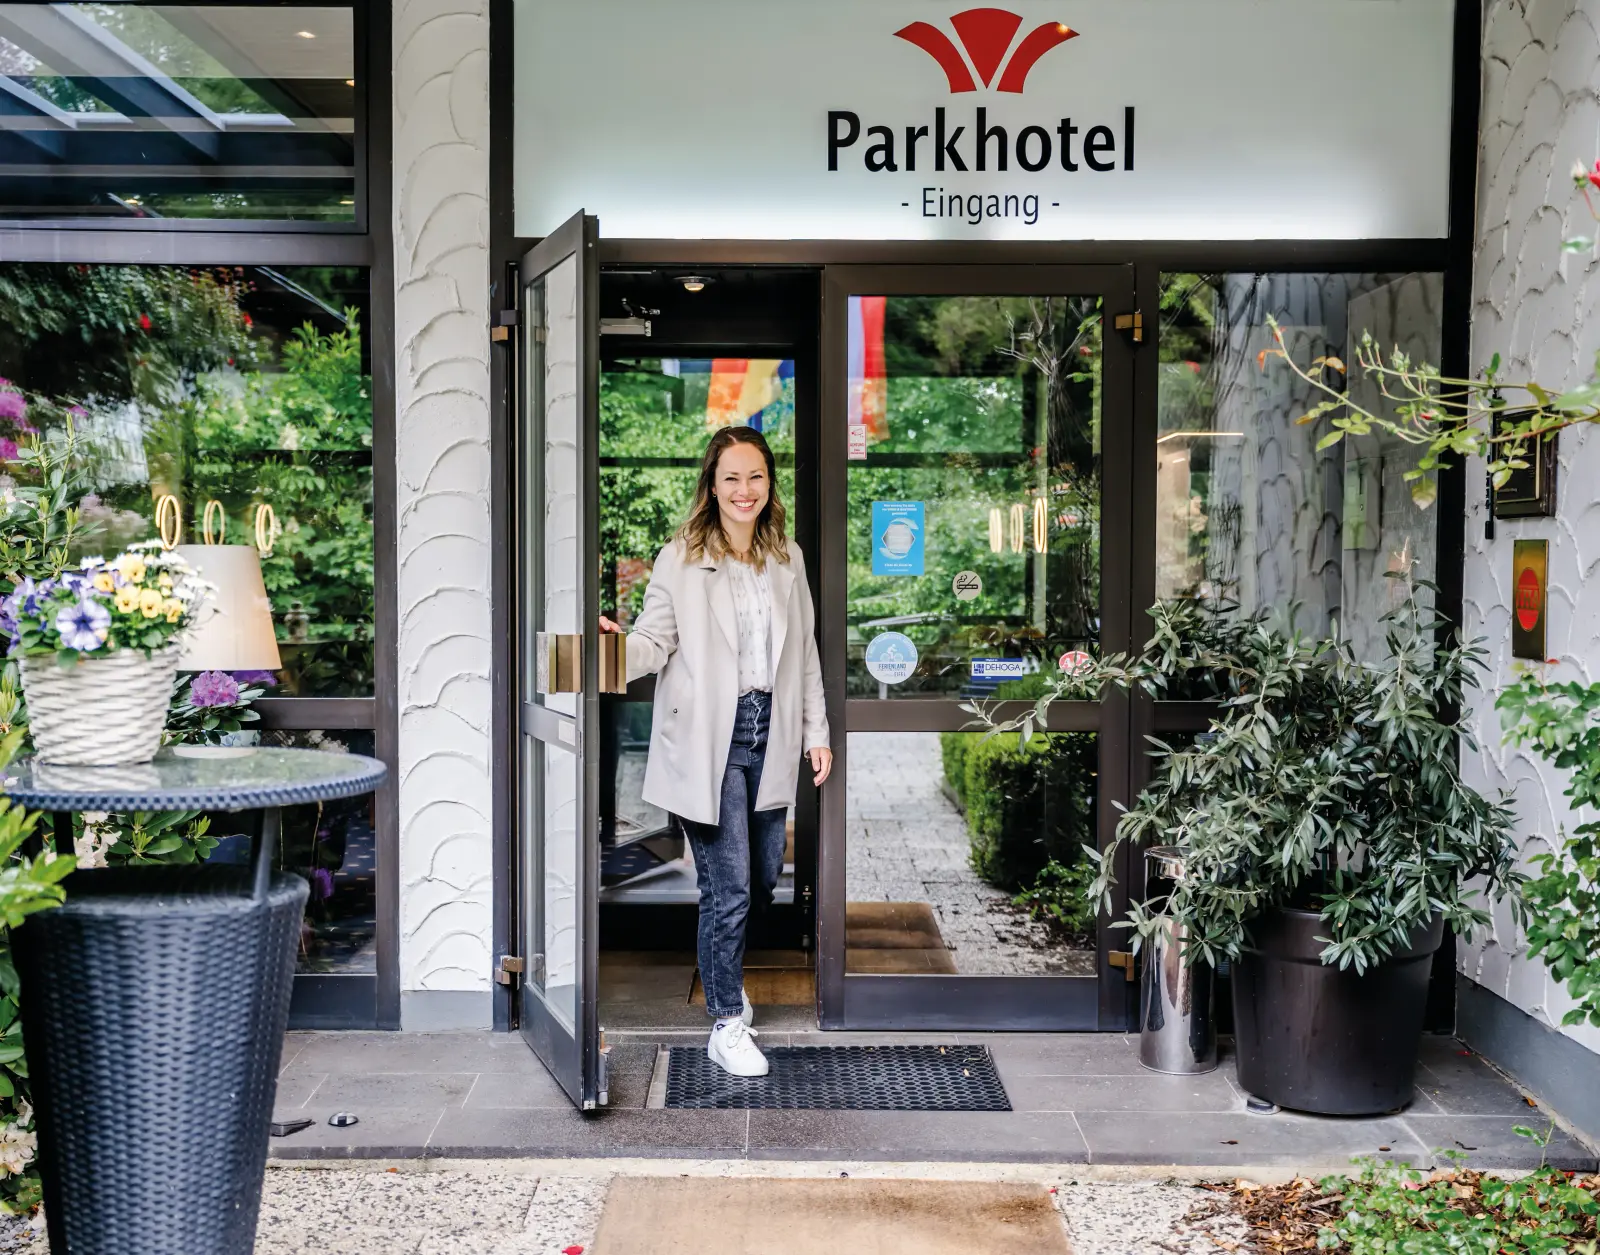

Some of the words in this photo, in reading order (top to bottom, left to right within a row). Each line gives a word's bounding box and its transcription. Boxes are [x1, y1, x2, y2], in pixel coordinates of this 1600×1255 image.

[827, 106, 1135, 172] Parkhotel
[922, 187, 1039, 225] Eingang
[985, 663, 1021, 671] DEHOGA
